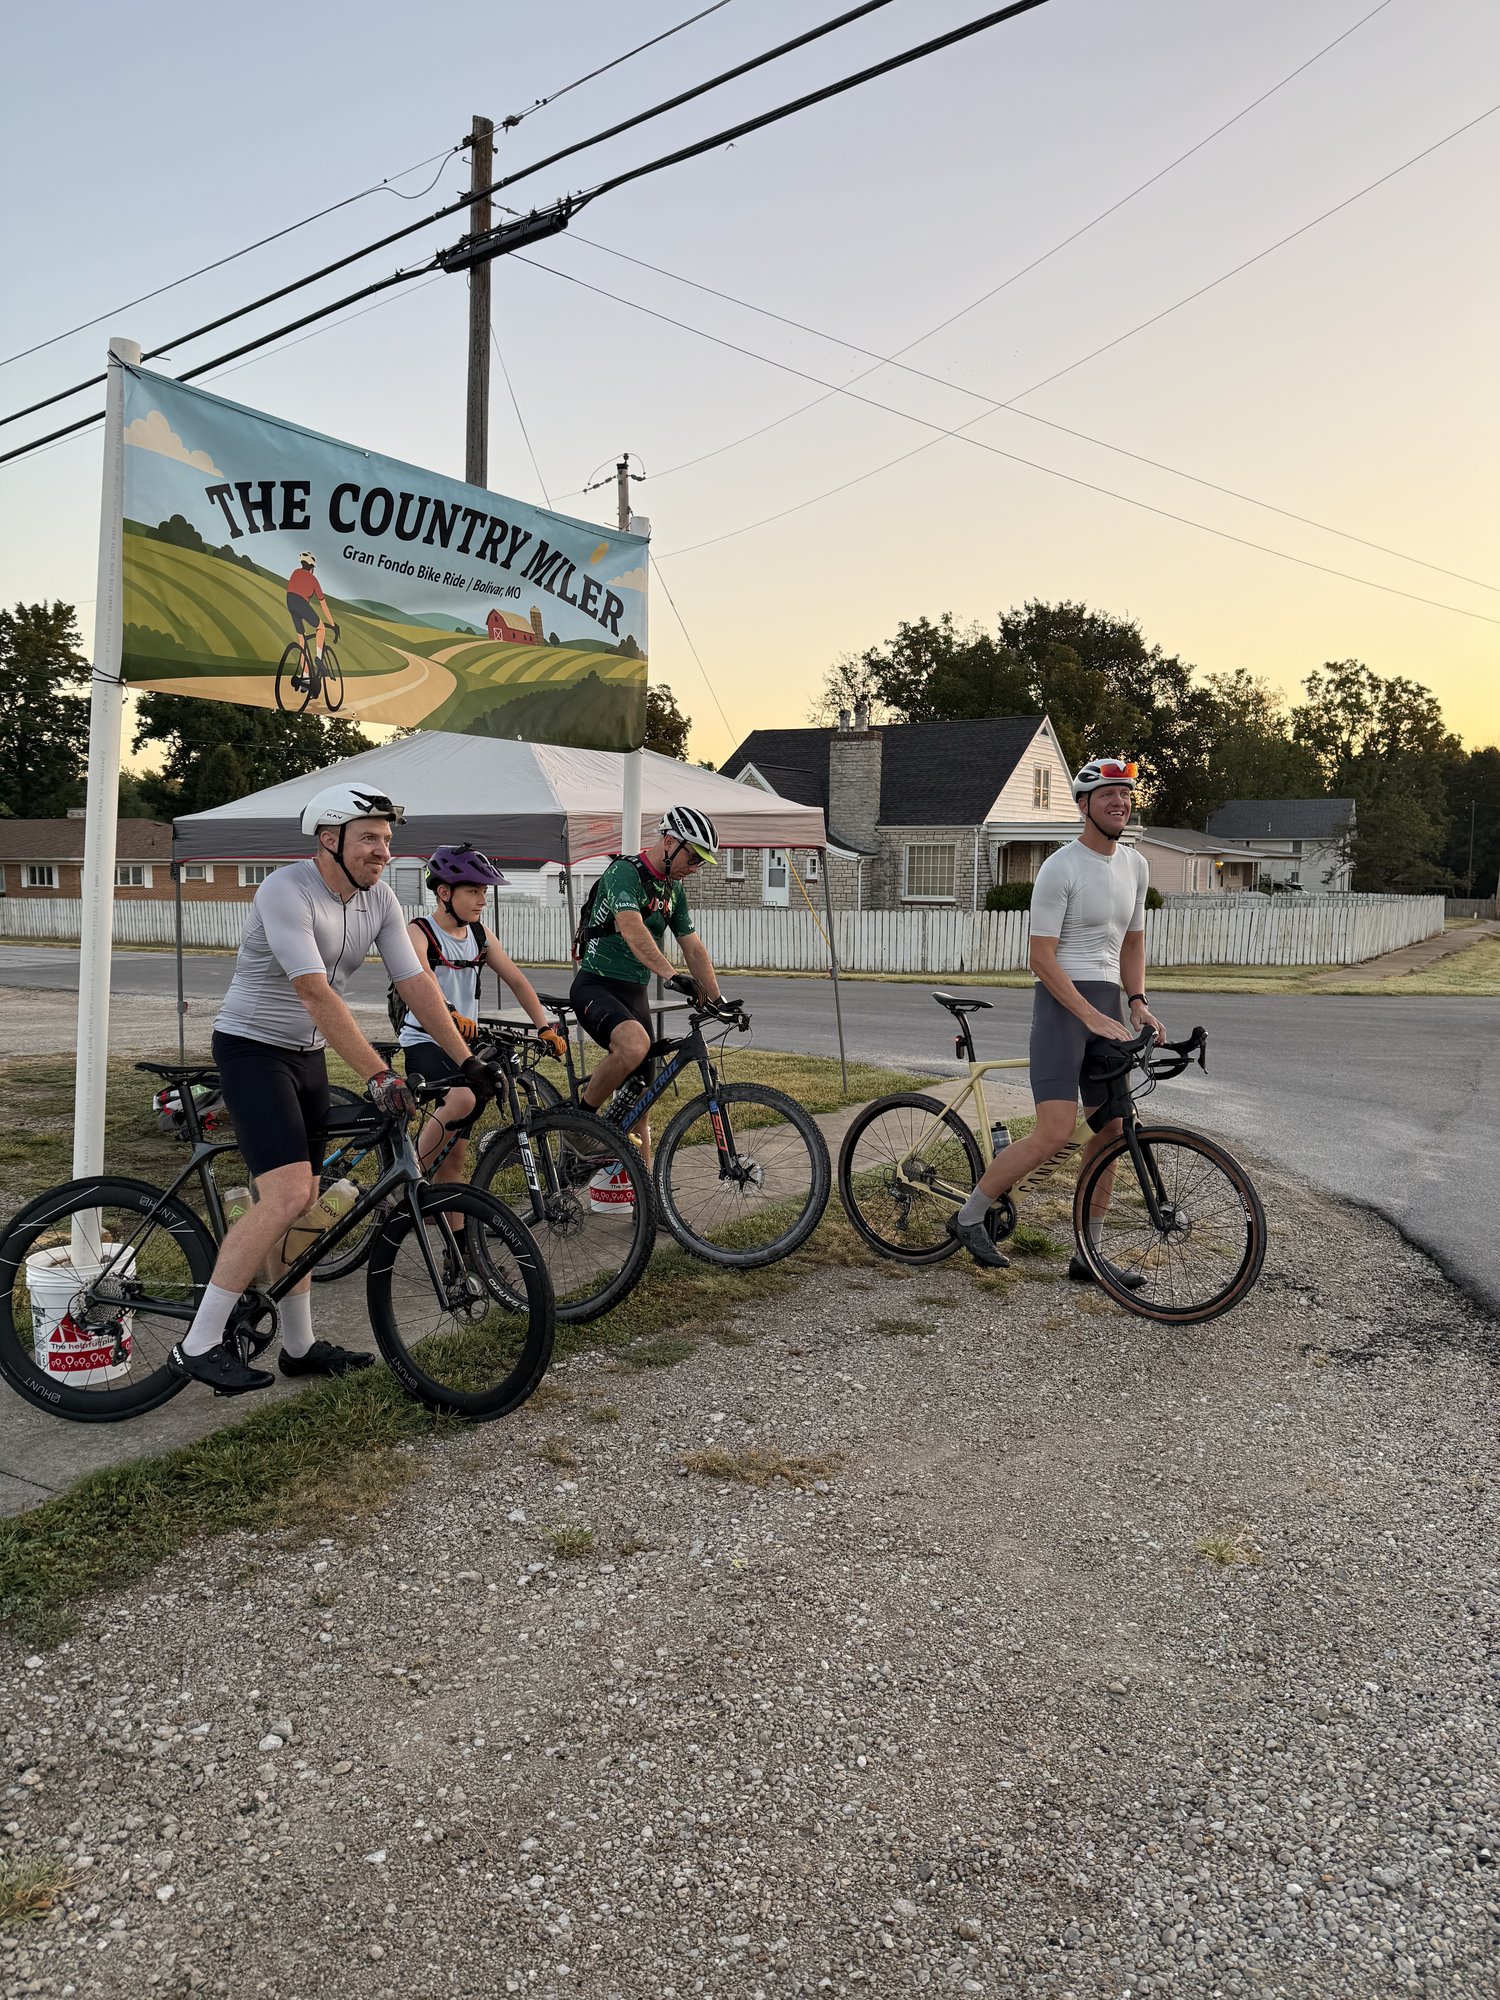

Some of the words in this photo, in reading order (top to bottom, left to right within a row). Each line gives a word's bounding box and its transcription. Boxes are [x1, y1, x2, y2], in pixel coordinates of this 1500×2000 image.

[204, 481, 311, 539] THE
[329, 483, 532, 570] COUNTRY
[520, 539, 624, 637] MILER
[342, 545, 374, 565] Gran
[377, 554, 415, 576] Fondo
[417, 565, 441, 583] Bike
[442, 572, 466, 588] Ride
[473, 579, 504, 598] Bolivar,
[505, 585, 521, 599] MO
[326, 812, 343, 820] KAV
[622, 1089, 656, 1133] SANTA
[653, 1059, 679, 1093] CRUZ
[1018, 1142, 1081, 1193] CANYON
[499, 1221, 523, 1248] HUNT
[68, 1340, 100, 1351] helpful
[391, 1356, 411, 1383] HUNT
[22, 1376, 53, 1400] HUNT
